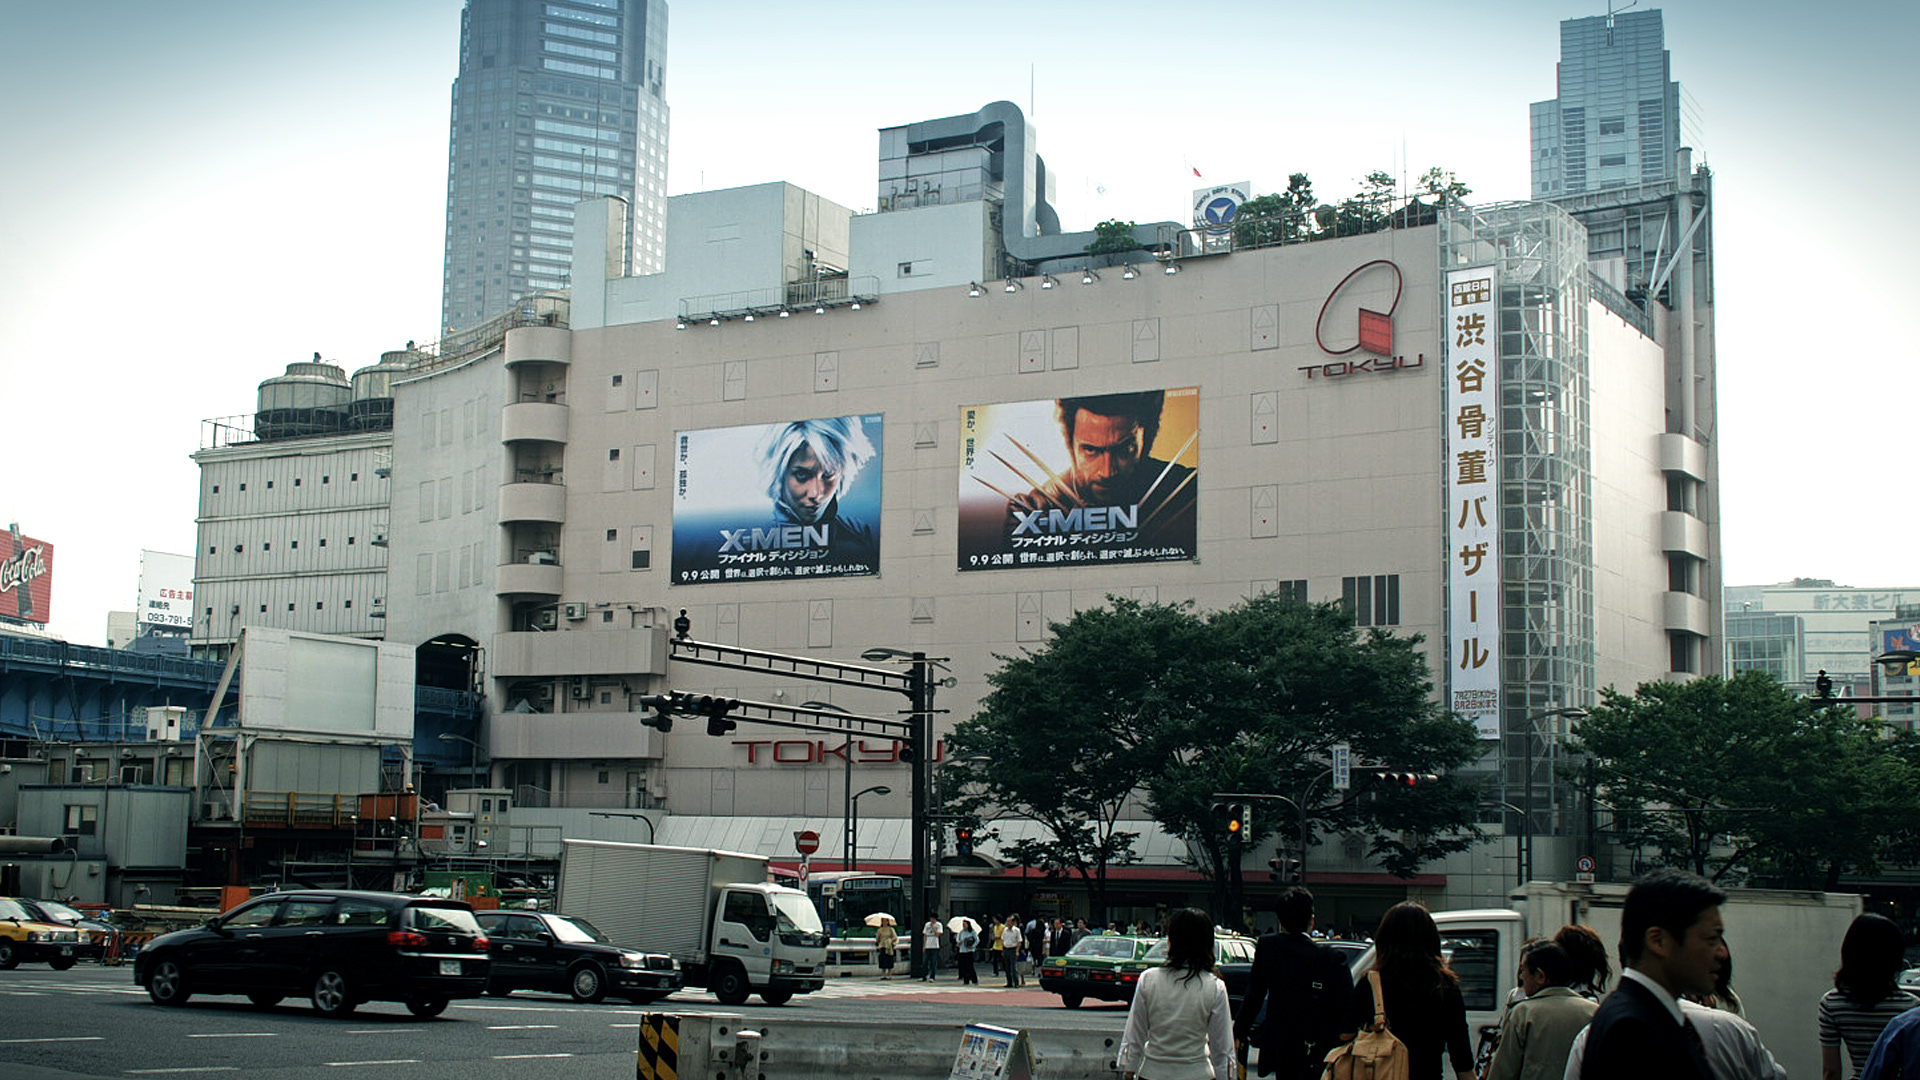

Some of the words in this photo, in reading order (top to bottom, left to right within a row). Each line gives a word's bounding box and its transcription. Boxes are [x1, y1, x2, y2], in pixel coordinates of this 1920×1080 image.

[1298, 353, 1423, 379] TOKYU
[1487, 417, 1495, 467] アンティーク
[1456, 313, 1490, 670] 渋谷骨董バザール
[1011, 504, 1138, 535] X-MEN
[718, 523, 829, 552] X-MEN
[1011, 536, 1067, 548] ファイナル
[1069, 531, 1139, 546] ディシジョン
[718, 553, 767, 566] ファイナル
[768, 548, 830, 563] ディシジョン
